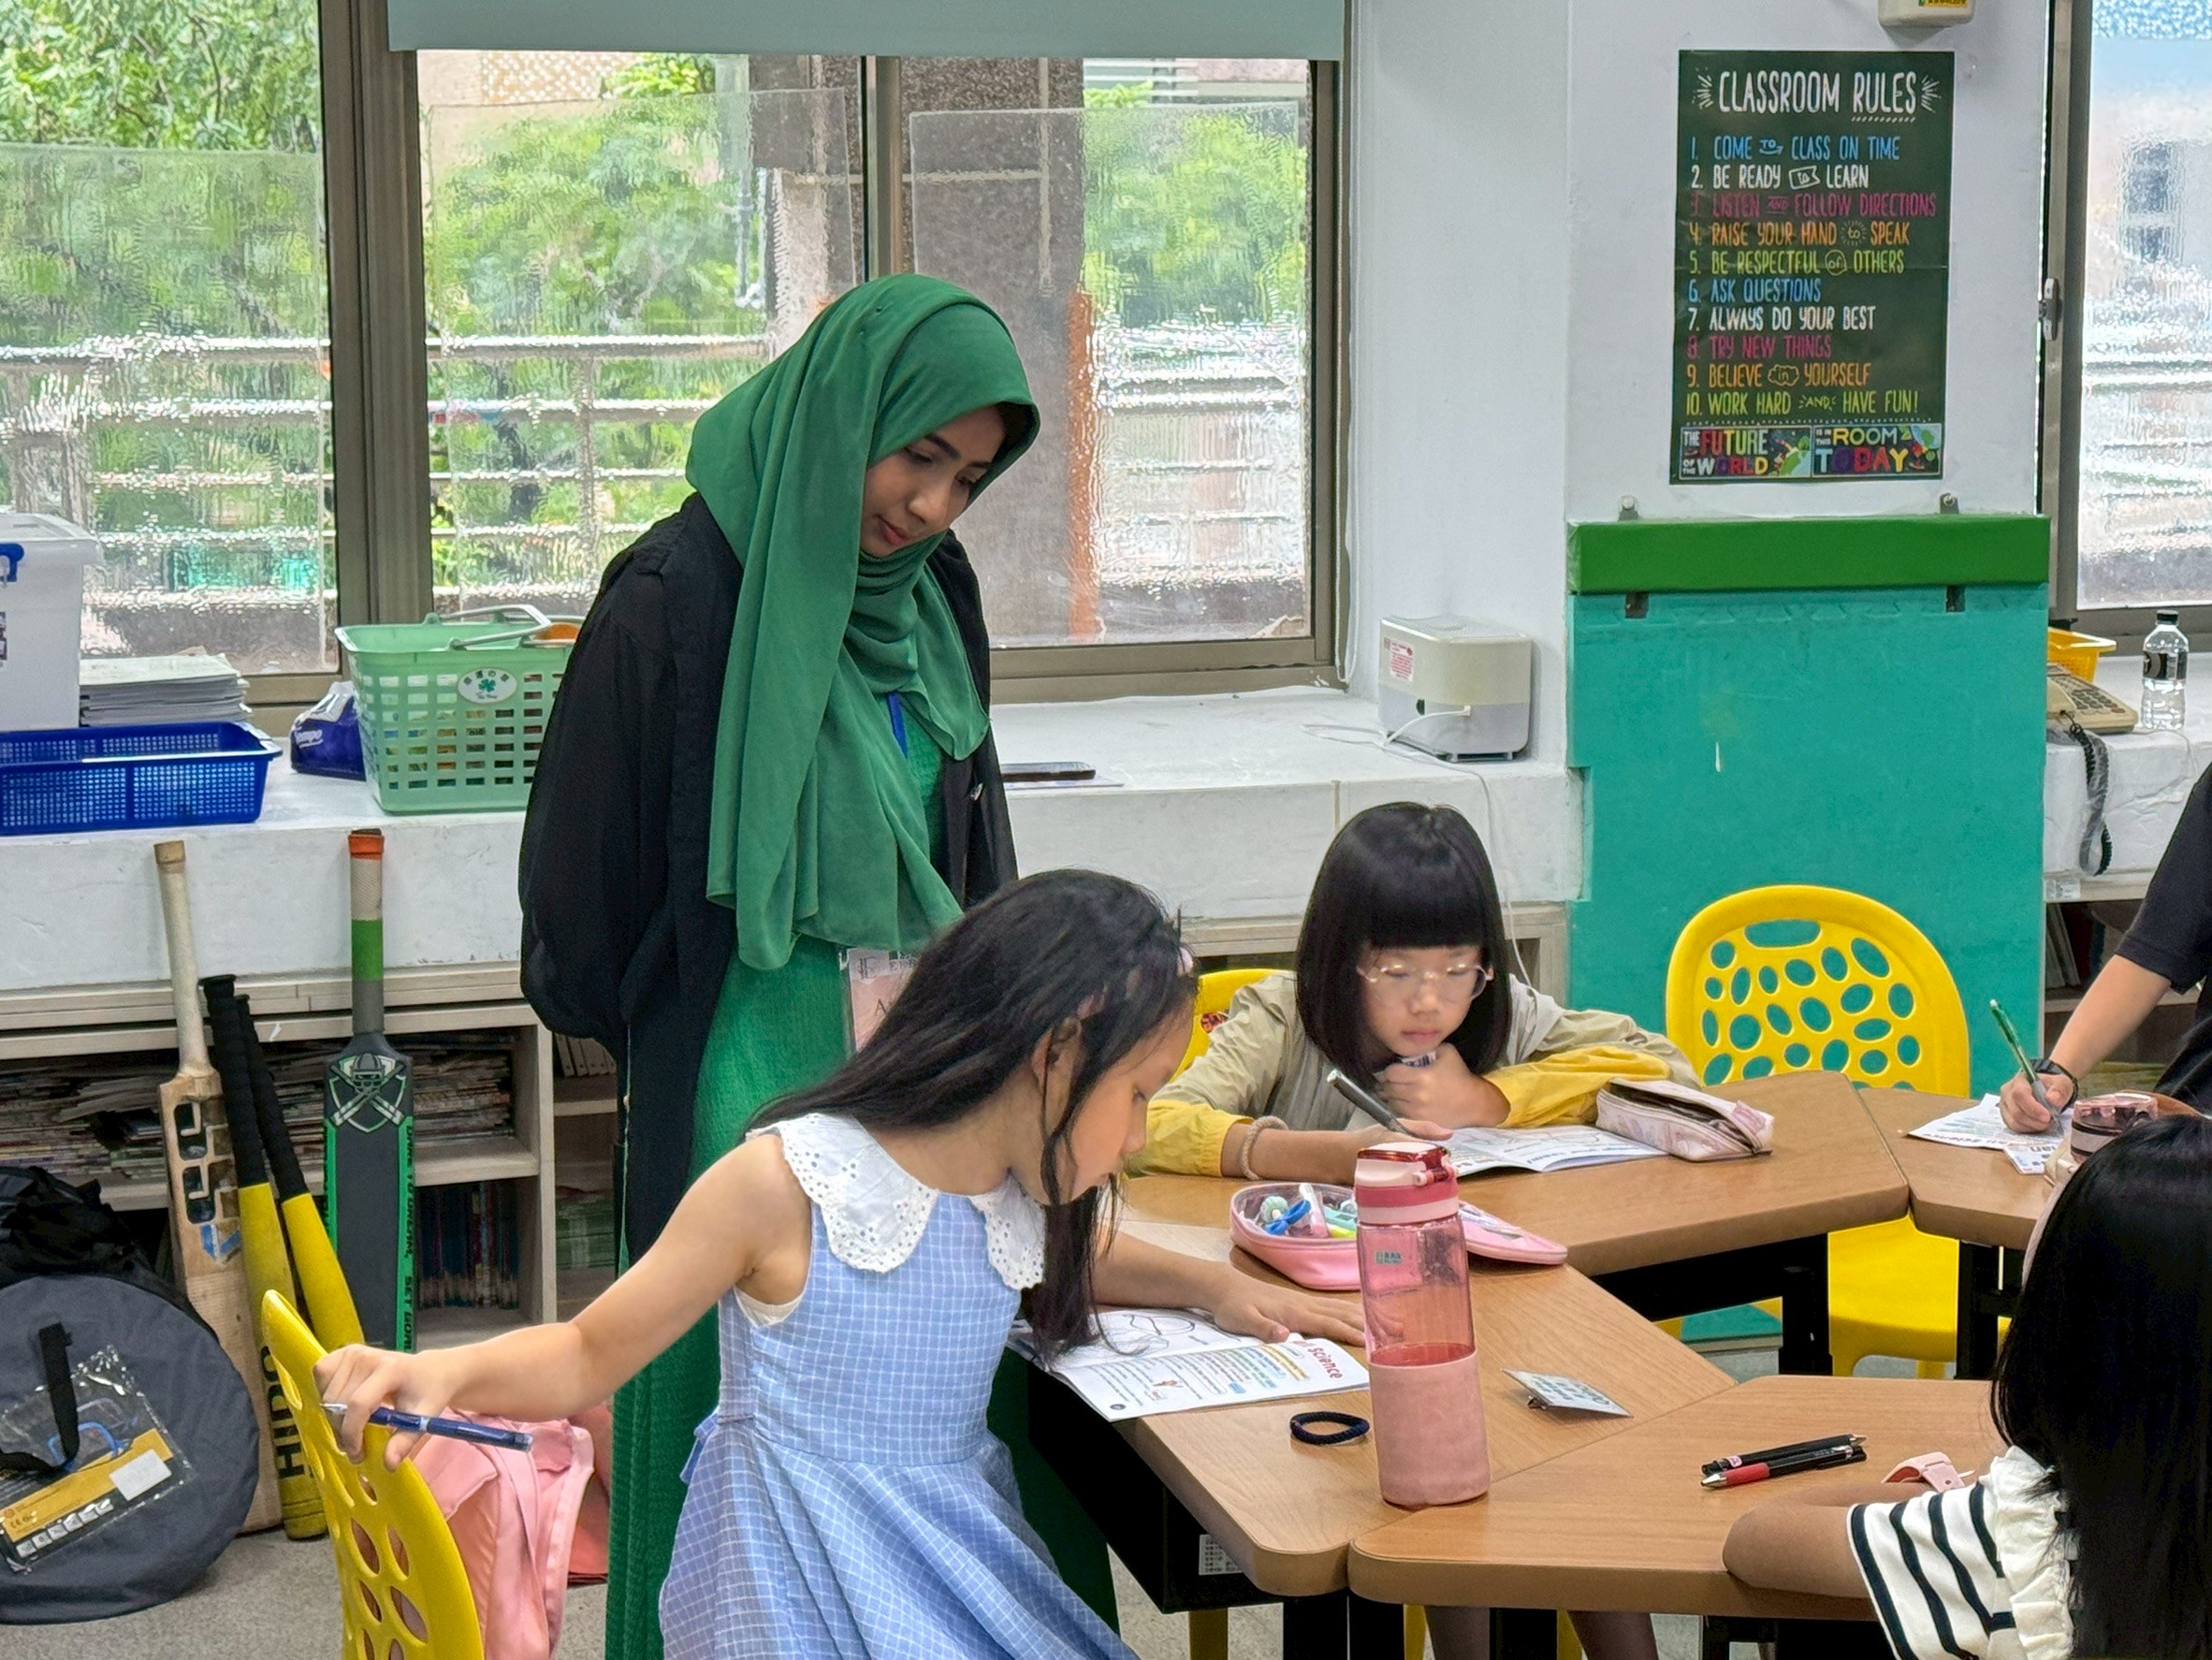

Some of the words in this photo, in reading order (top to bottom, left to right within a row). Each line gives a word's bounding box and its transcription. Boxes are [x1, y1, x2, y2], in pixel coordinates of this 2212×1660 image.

[1718, 70, 1841, 114] CLASSROOM
[1852, 70, 1917, 113] RULES
[1690, 136, 1698, 160] 1.
[1713, 136, 1753, 160] COME
[1791, 136, 1830, 160] CLASS
[1840, 137, 1858, 160] ON
[1868, 136, 1900, 160] TIME
[1691, 167, 1703, 189] 2.
[1713, 165, 1729, 189] BE
[1739, 165, 1781, 189] READY
[1826, 165, 1869, 189] LEARN
[1711, 194, 1760, 217] LISTEN
[1793, 194, 1851, 217] FOLLOW
[1859, 193, 1936, 217] DIRECTIONS
[1690, 223, 1701, 246] 4.
[1711, 222, 1748, 246] RAISE
[1757, 222, 1793, 246] YOUR
[1801, 222, 1837, 245] HAND
[1870, 222, 1910, 245] SPEAK
[1690, 251, 1701, 275] 5.
[1711, 251, 1728, 274] BE
[1737, 250, 1821, 274] RESPECTFUL
[1854, 250, 1904, 273] OTHERS
[1688, 280, 1701, 303] 6.
[1710, 279, 1735, 303] ASK
[1743, 278, 1821, 303] QUESTIONS
[1688, 308, 1699, 331] 7.
[1710, 306, 1764, 331] ALWAYS
[1772, 306, 1791, 330] DO
[1799, 306, 1835, 330] YOUR
[1842, 305, 1876, 330] BEST
[1710, 335, 1735, 359] TRY
[1742, 335, 1776, 358] NEW
[1783, 334, 1831, 358] THINGS
[1687, 364, 1699, 387] 9.
[1709, 363, 1763, 387] BELIEVE
[1804, 362, 1871, 387] YOURSELF
[1686, 391, 1703, 416] 10.
[1708, 391, 1748, 415] WORK
[1756, 391, 1791, 415] HARD
[1806, 396, 1829, 408] AND
[1842, 390, 1877, 414] HAVE
[1885, 390, 1918, 414] FUN!
[1683, 430, 1700, 446] THE
[1700, 429, 1768, 457] FUTURE
[1816, 437, 1831, 445] THIS
[1832, 427, 1898, 446] ROOM
[1682, 459, 1695, 468] OF
[1696, 456, 1768, 476] WORLD
[1815, 445, 1909, 473] TODAY
